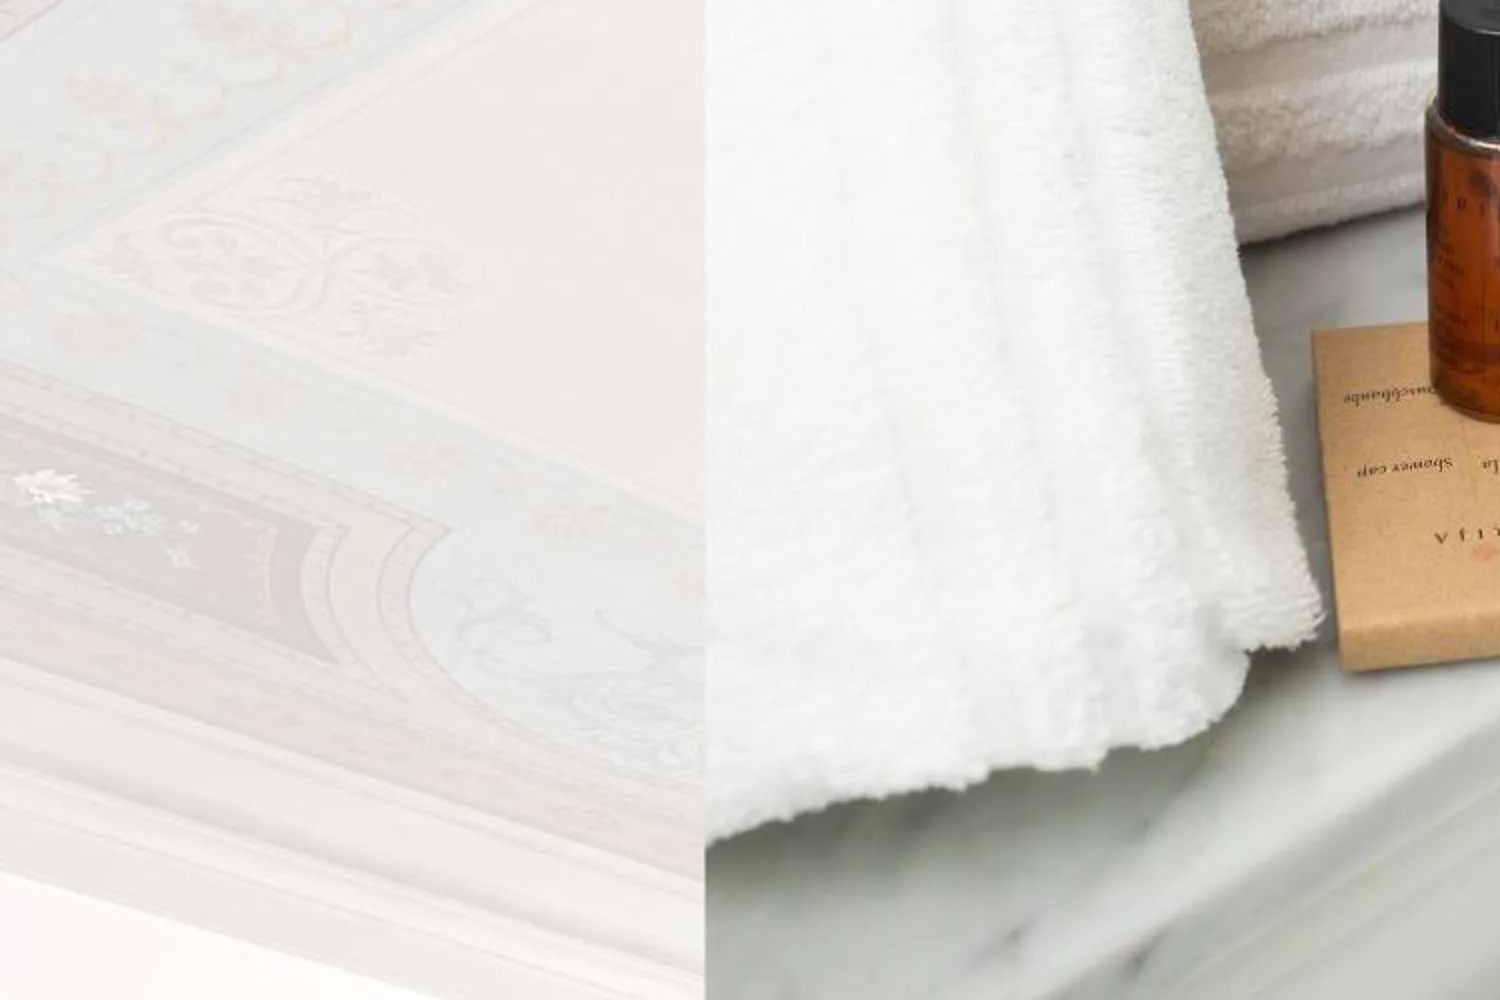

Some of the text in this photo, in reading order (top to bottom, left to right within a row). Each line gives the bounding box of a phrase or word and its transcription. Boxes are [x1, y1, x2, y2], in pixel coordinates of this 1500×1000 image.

[1357, 456, 1454, 478] Shower cap
[1482, 459, 1500, 475] la
